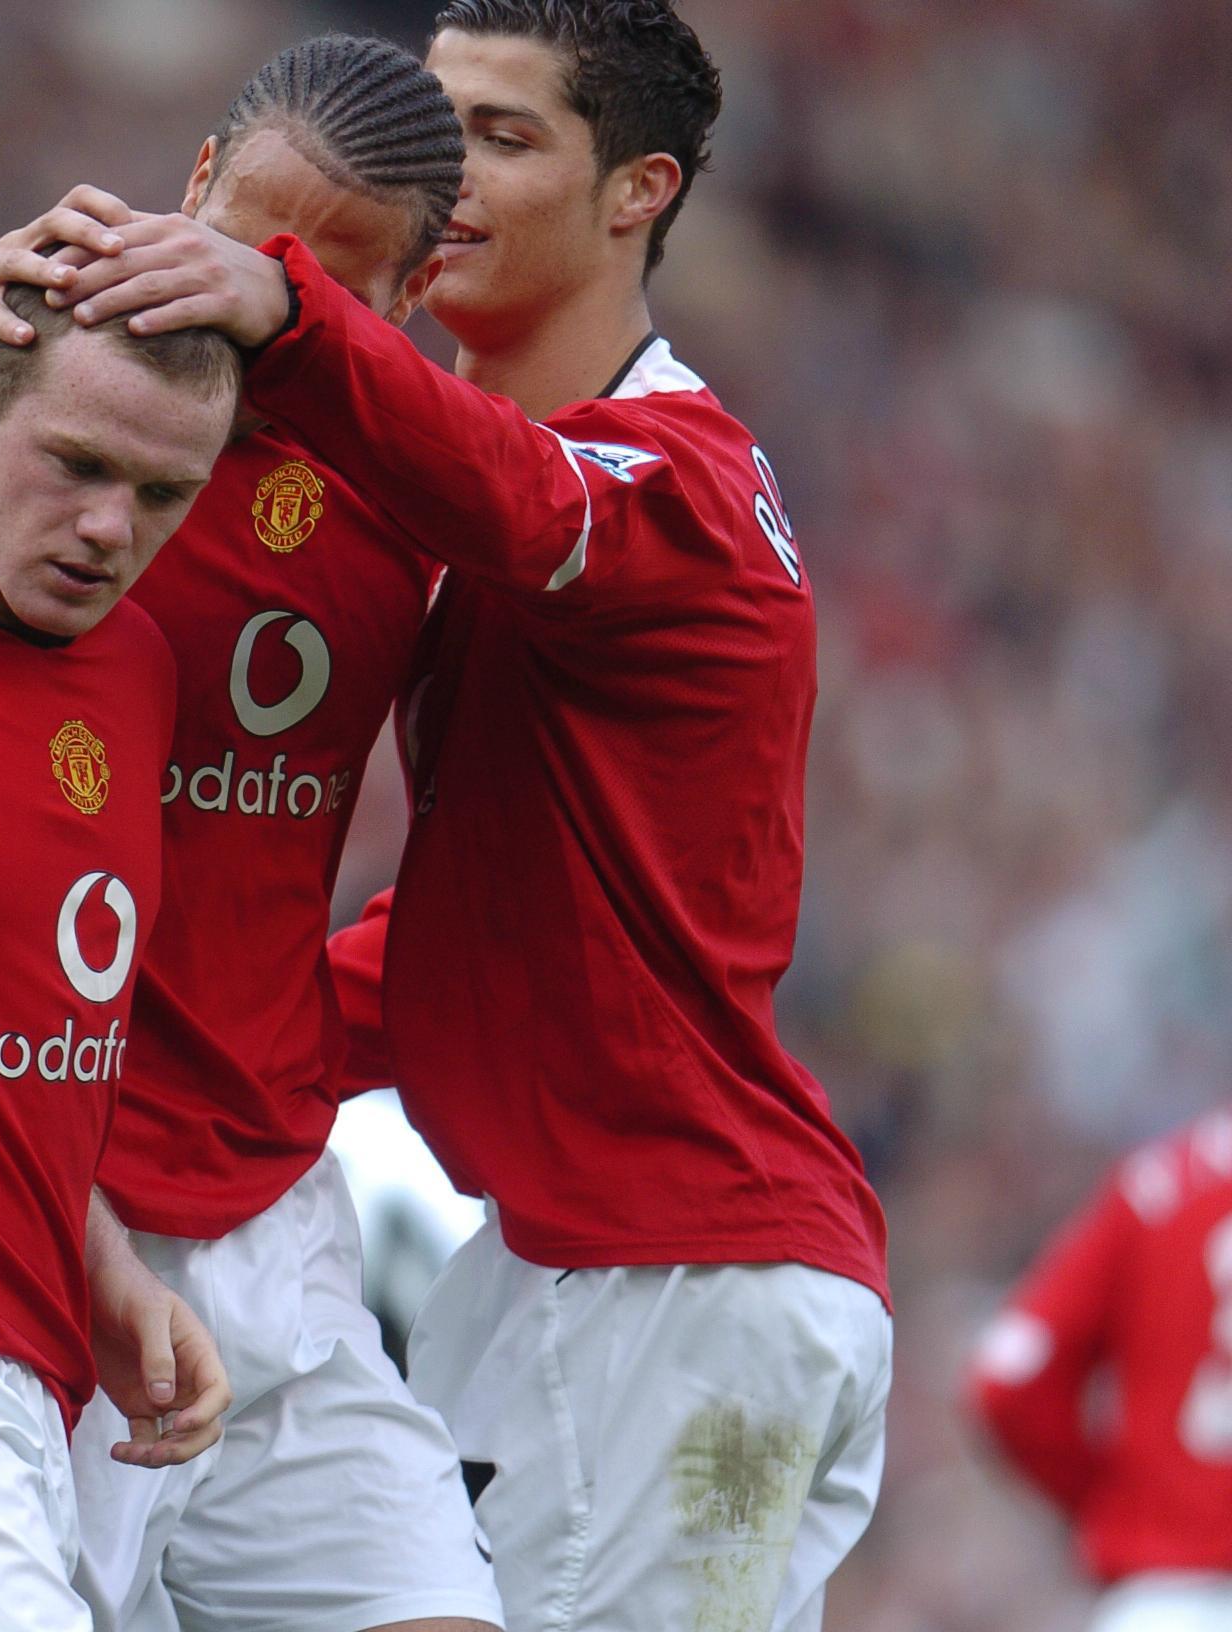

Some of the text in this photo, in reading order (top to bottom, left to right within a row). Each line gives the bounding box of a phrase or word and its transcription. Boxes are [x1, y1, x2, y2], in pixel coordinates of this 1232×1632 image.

[261, 466, 317, 495] MANCHESTER
[263, 529, 303, 546] UNITED
[53, 727, 101, 758] MANCHESTER
[71, 791, 103, 808] UNITED
